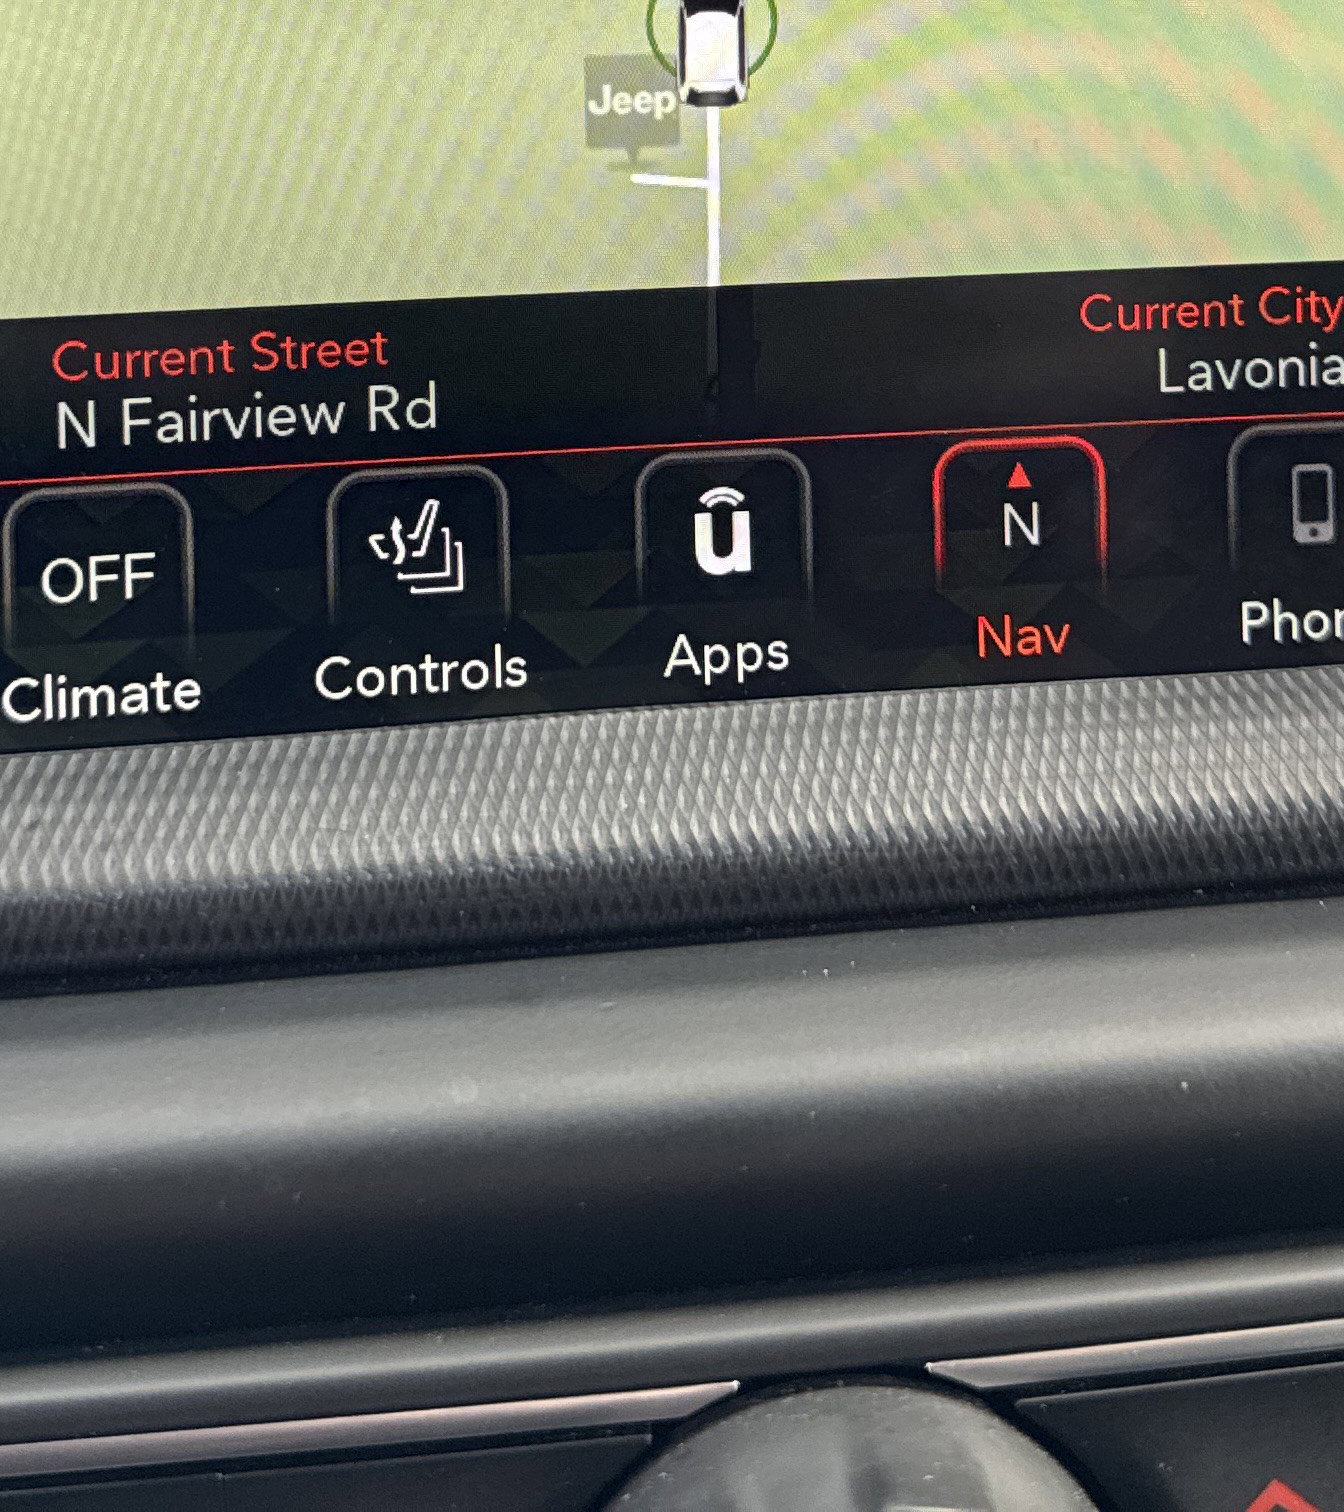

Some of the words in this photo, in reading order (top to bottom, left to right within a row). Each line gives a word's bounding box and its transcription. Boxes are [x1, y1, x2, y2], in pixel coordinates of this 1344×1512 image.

[587, 83, 678, 122] Jeep
[1079, 291, 1246, 332] Current
[52, 337, 235, 382] Current
[249, 329, 390, 373] Street
[56, 399, 97, 451] N
[119, 389, 346, 448] Fairview
[366, 379, 438, 433] Rd
[1002, 499, 1041, 547] N
[40, 551, 157, 606] OFF
[662, 632, 790, 686] Apps
[976, 613, 1071, 659] Nav
[314, 642, 529, 701] Controls
[0, 670, 203, 727] Climate
